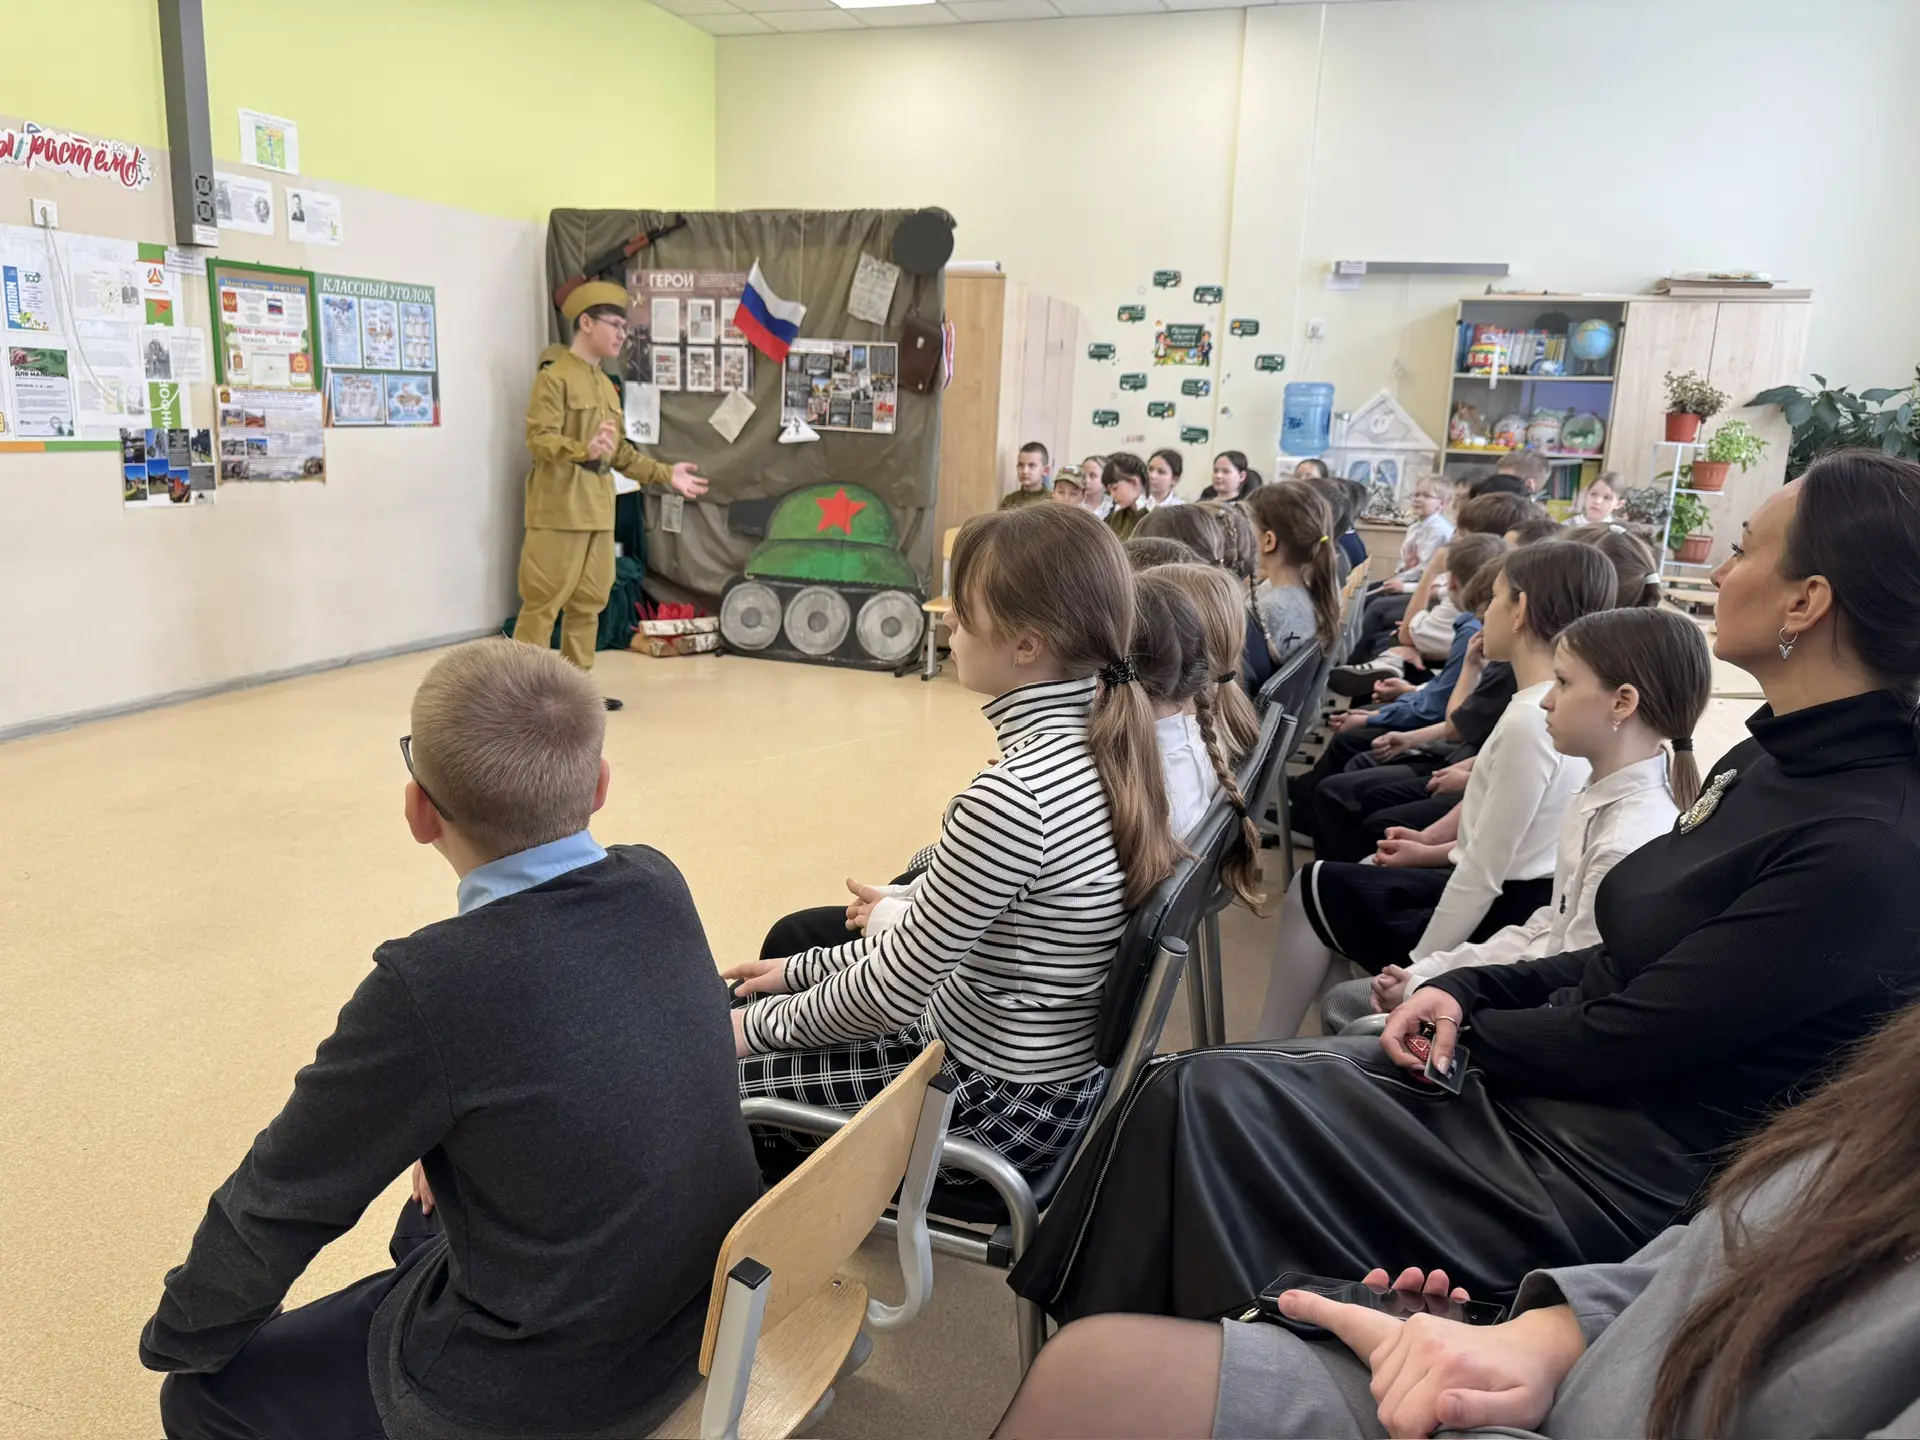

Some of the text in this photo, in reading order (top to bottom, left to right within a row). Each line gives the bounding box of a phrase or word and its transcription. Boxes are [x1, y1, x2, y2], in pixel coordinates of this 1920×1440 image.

[323, 277, 432, 303] КЛАССНЫЙ УГОЛОК
[649, 273, 694, 288] ГЕРОИ
[6, 281, 19, 321] ДИПЛОМ
